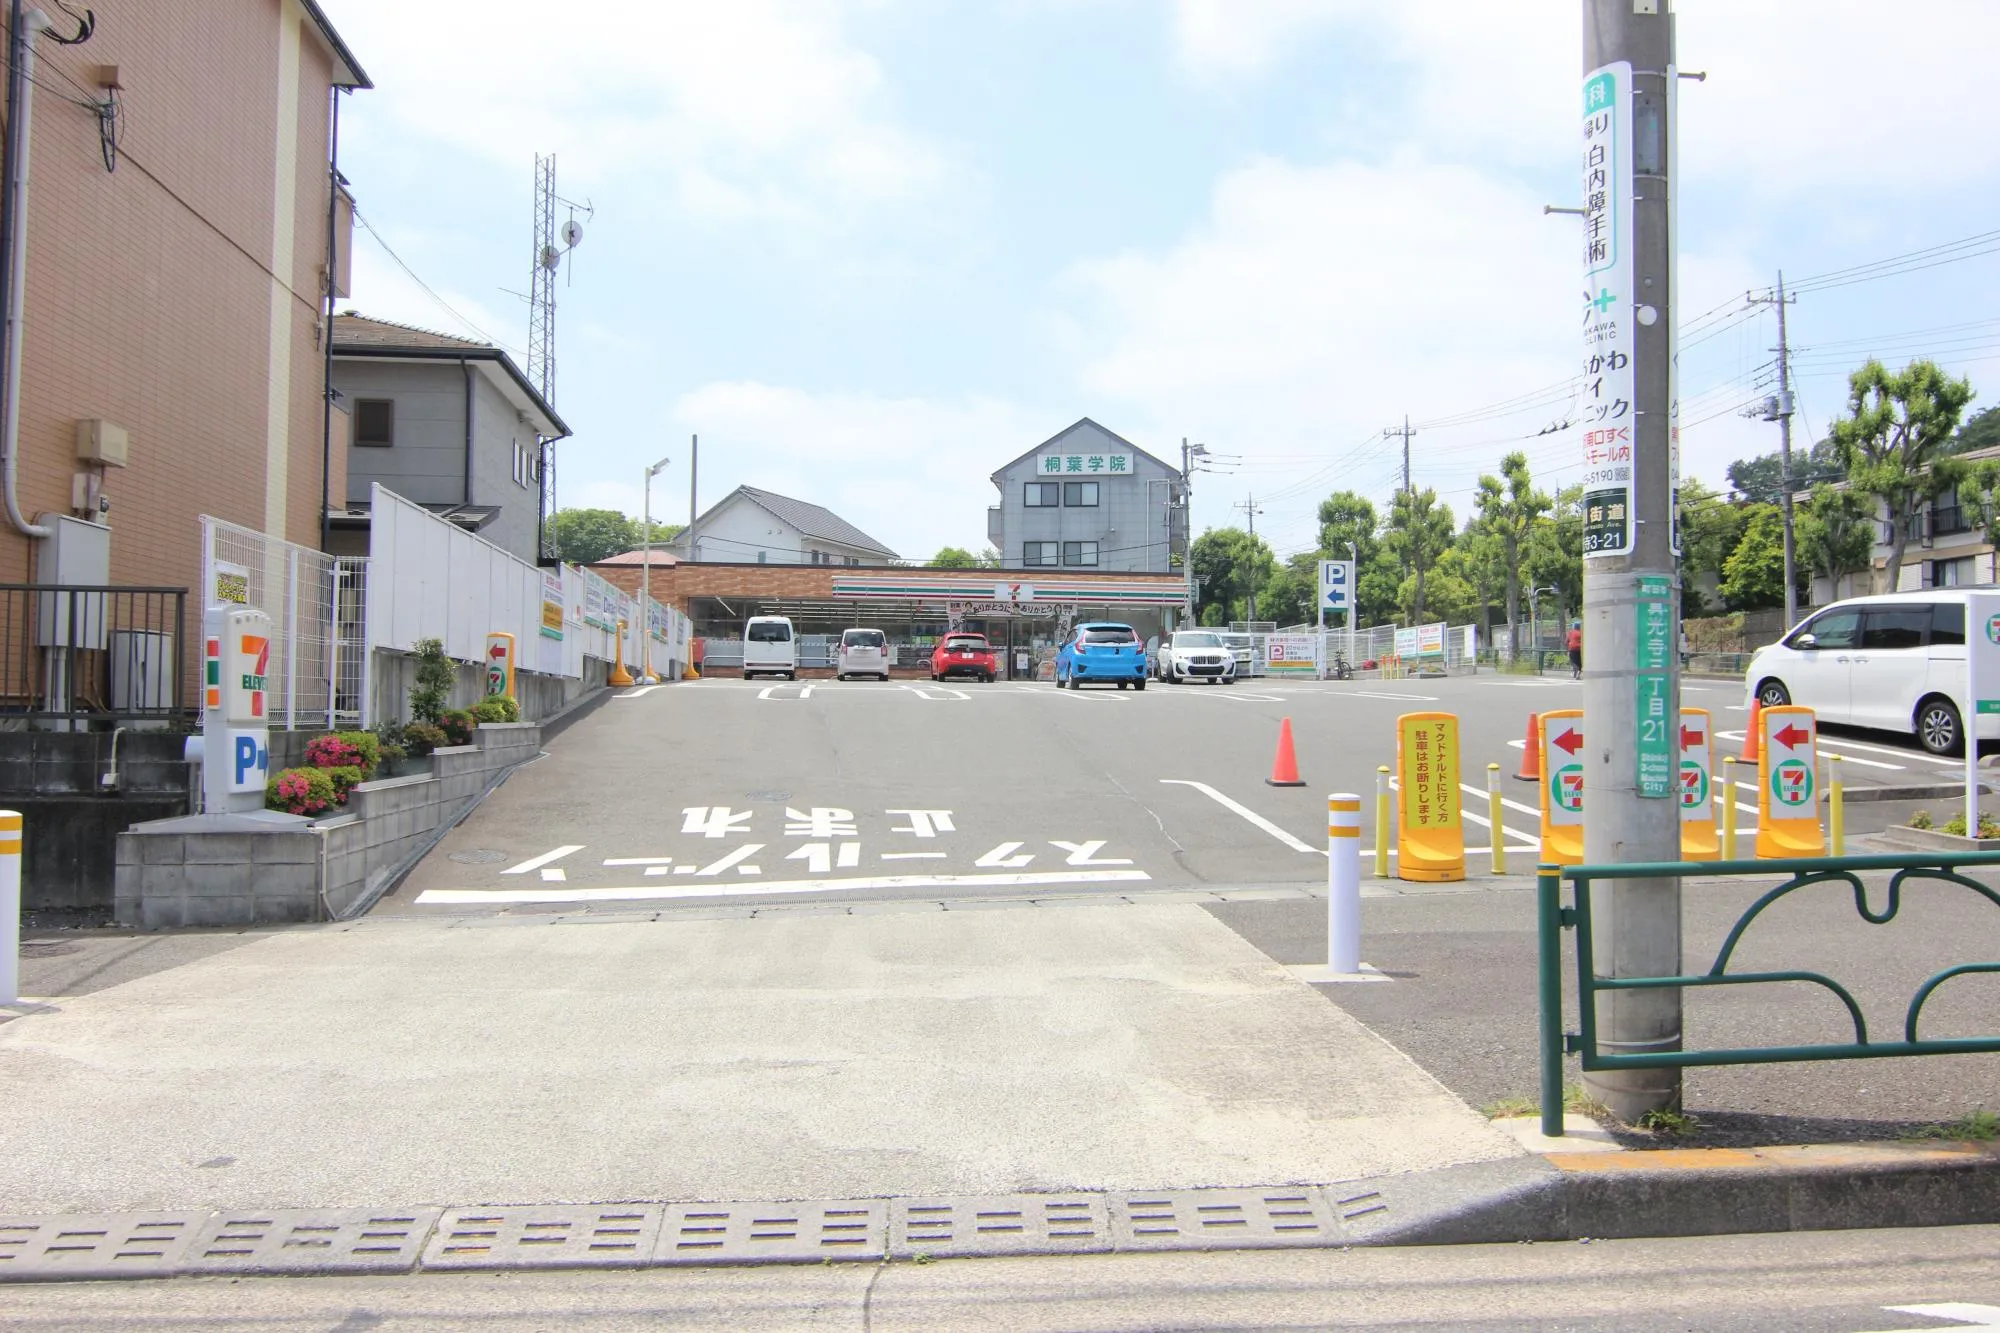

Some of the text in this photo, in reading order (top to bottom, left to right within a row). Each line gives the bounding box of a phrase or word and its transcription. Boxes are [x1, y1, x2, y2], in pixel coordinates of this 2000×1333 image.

[1588, 144, 1607, 264] 白内障手術
[1045, 456, 1126, 472] 桐葉学院
[1585, 503, 1625, 525] 街道
[1328, 564, 1345, 584] P
[241, 634, 270, 716] 7
[1642, 720, 1665, 742] 21
[235, 736, 257, 785] P
[1435, 723, 1448, 823] マクドナルドに行く方
[1416, 730, 1430, 825] 駐車はお断りします
[1643, 782, 1664, 792] City
[1783, 771, 1804, 801] 7
[681, 806, 956, 838] 止まれ
[499, 841, 1135, 881] スクールゾーン
